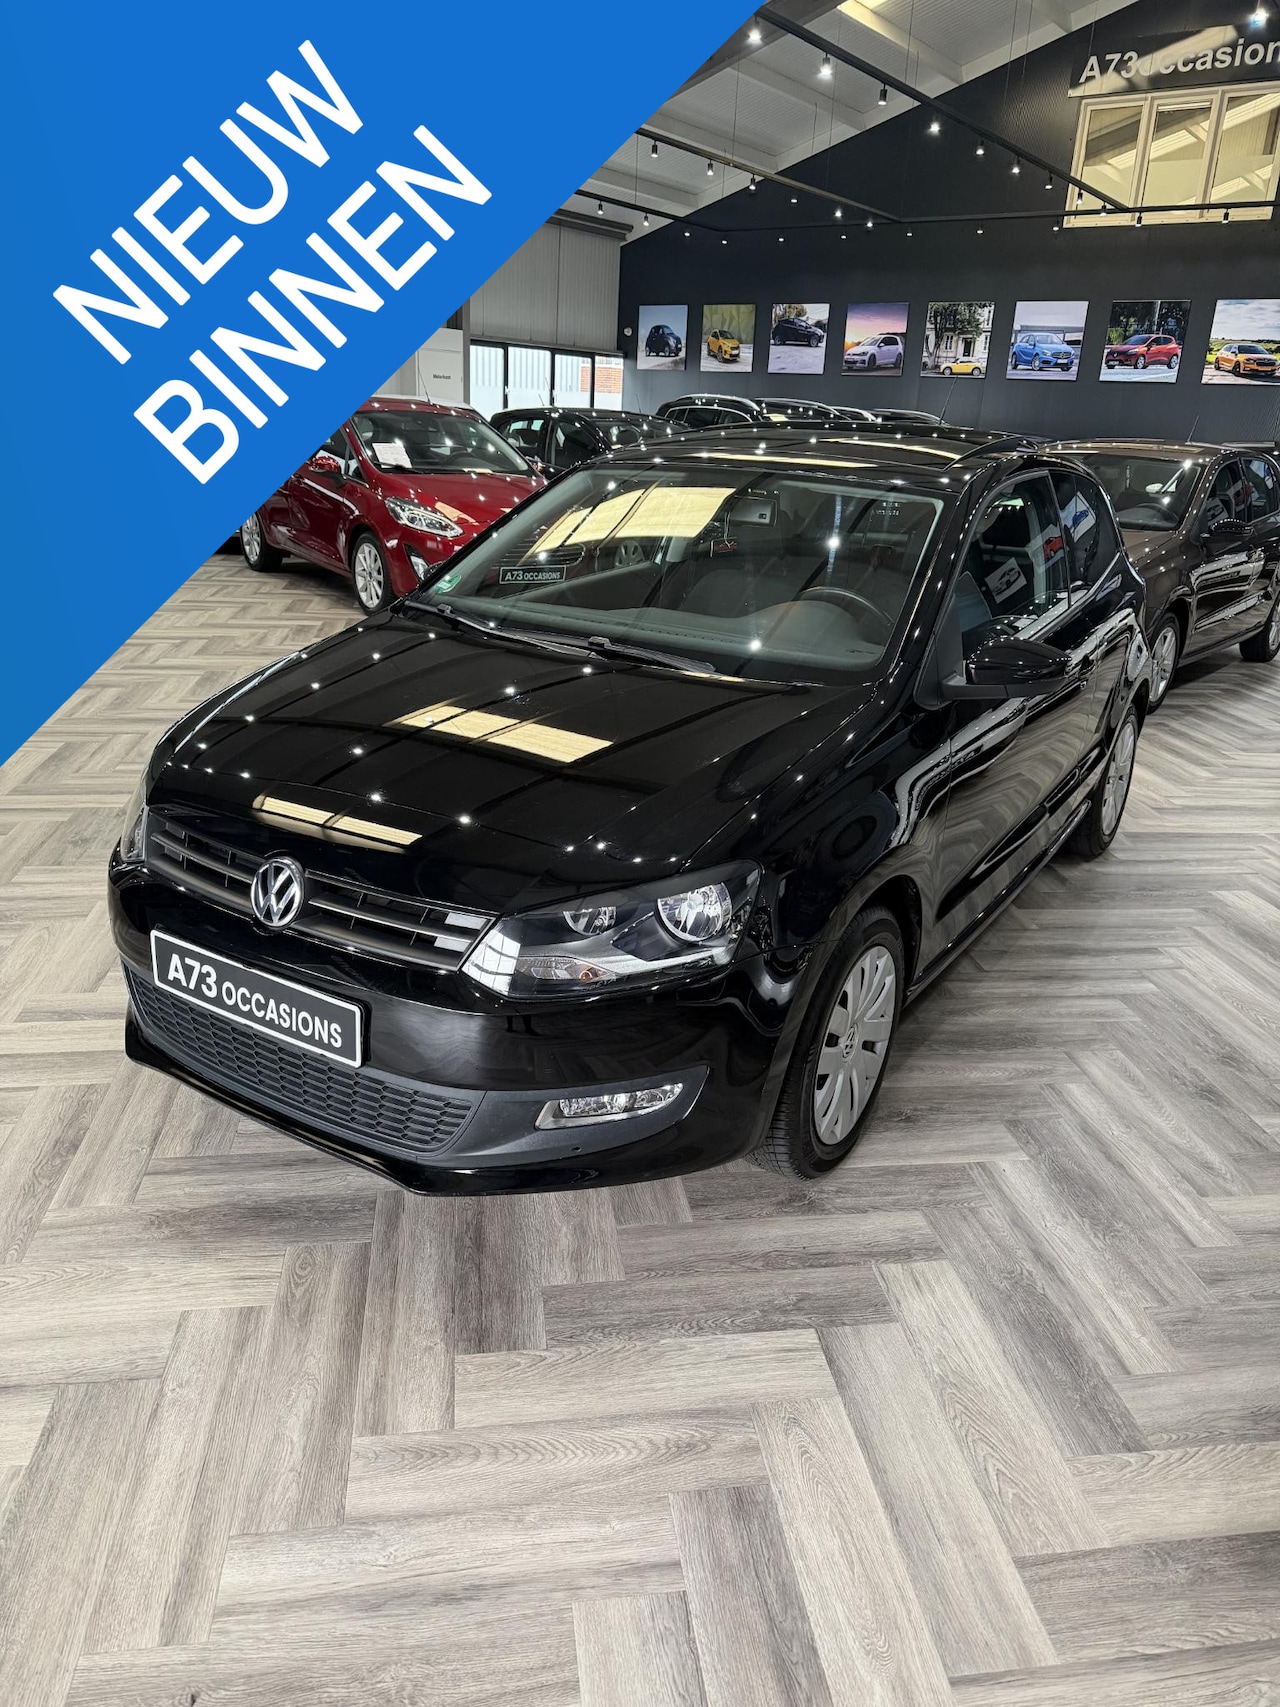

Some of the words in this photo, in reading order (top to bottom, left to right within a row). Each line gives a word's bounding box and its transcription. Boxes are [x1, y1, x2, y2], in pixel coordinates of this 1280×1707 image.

[505, 571, 523, 580] A73
[524, 571, 560, 580] OCCASIONS
[168, 953, 218, 998] A73
[221, 981, 342, 1048] OCCASIONS
